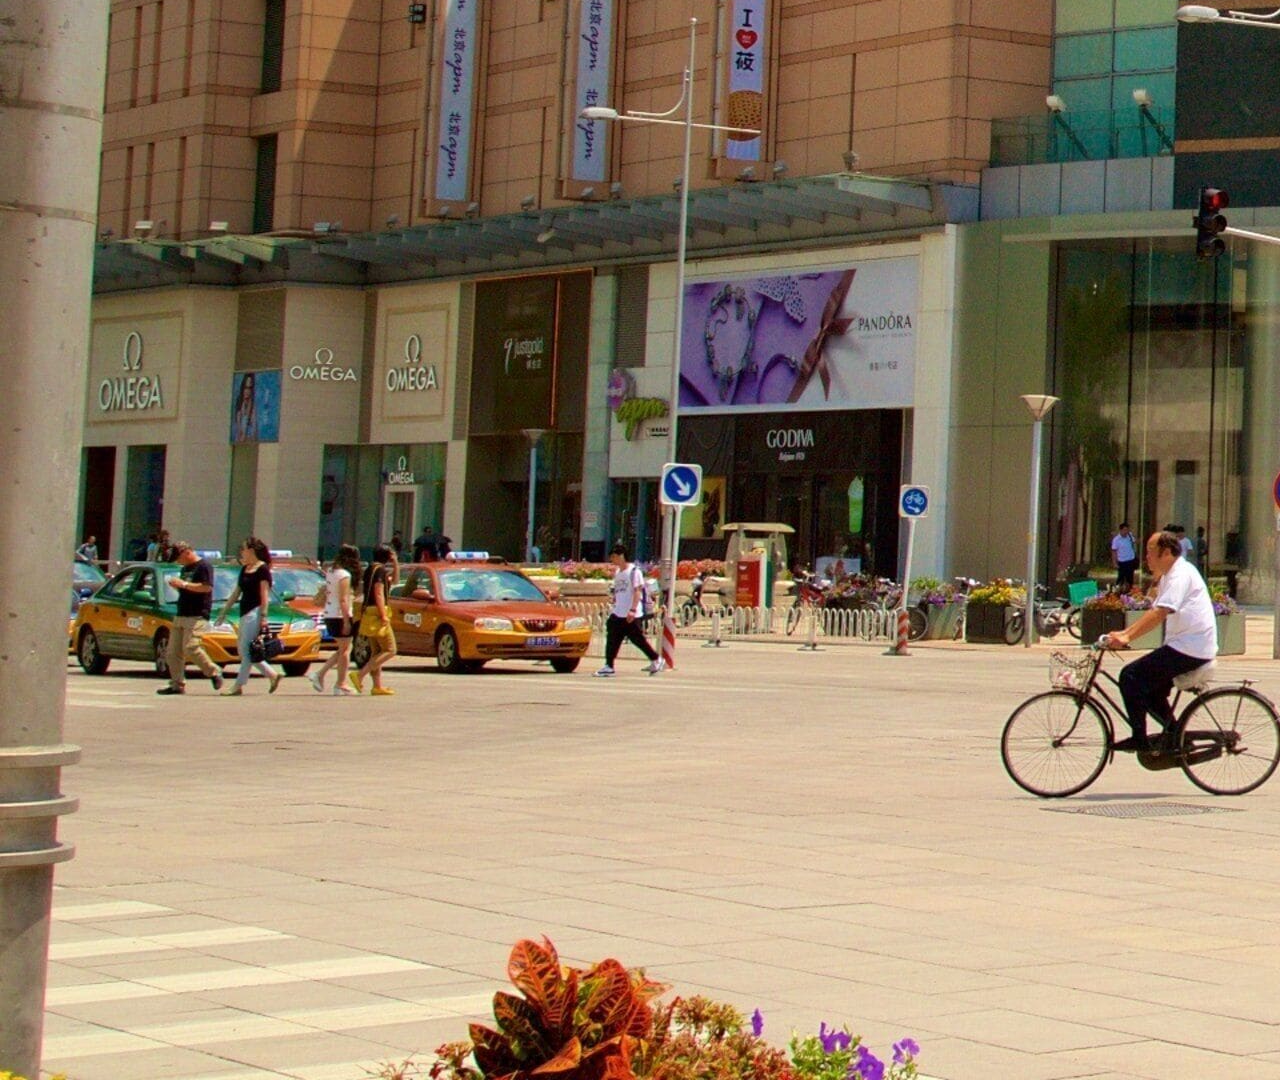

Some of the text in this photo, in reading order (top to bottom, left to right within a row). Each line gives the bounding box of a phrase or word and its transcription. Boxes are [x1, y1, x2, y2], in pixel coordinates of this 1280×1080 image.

[742, 8, 753, 27] I
[735, 51, 755, 71] 莜
[289, 365, 357, 382] OMEGA
[386, 367, 438, 392] OMEGA
[99, 375, 163, 412] OMEGA
[766, 429, 815, 448] GODIVA
[388, 471, 415, 484] OMEGA
